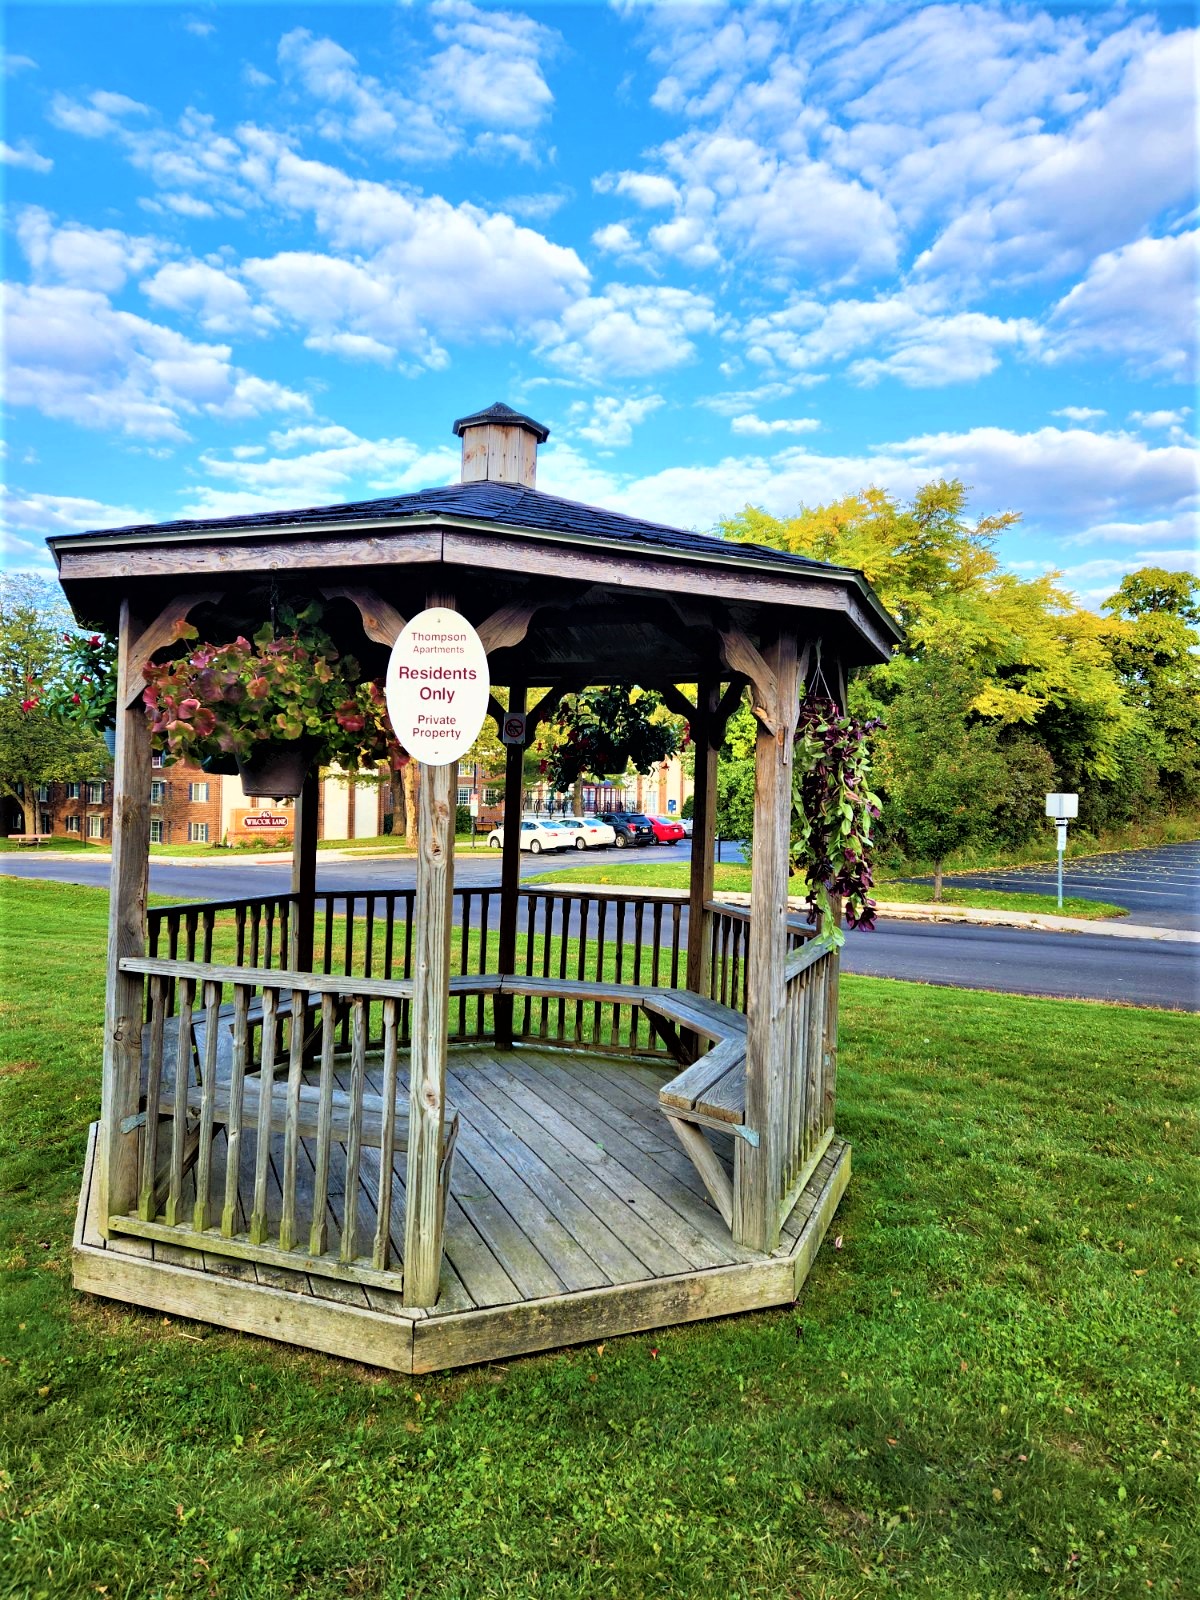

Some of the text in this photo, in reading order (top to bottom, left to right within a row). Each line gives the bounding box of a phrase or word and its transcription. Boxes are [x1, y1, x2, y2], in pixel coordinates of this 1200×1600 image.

[411, 632, 467, 642] Thompson
[412, 645, 465, 655] Apartments
[399, 666, 477, 680] Residents
[419, 686, 455, 703] Only
[417, 714, 456, 725] Private
[412, 728, 461, 740] Property
